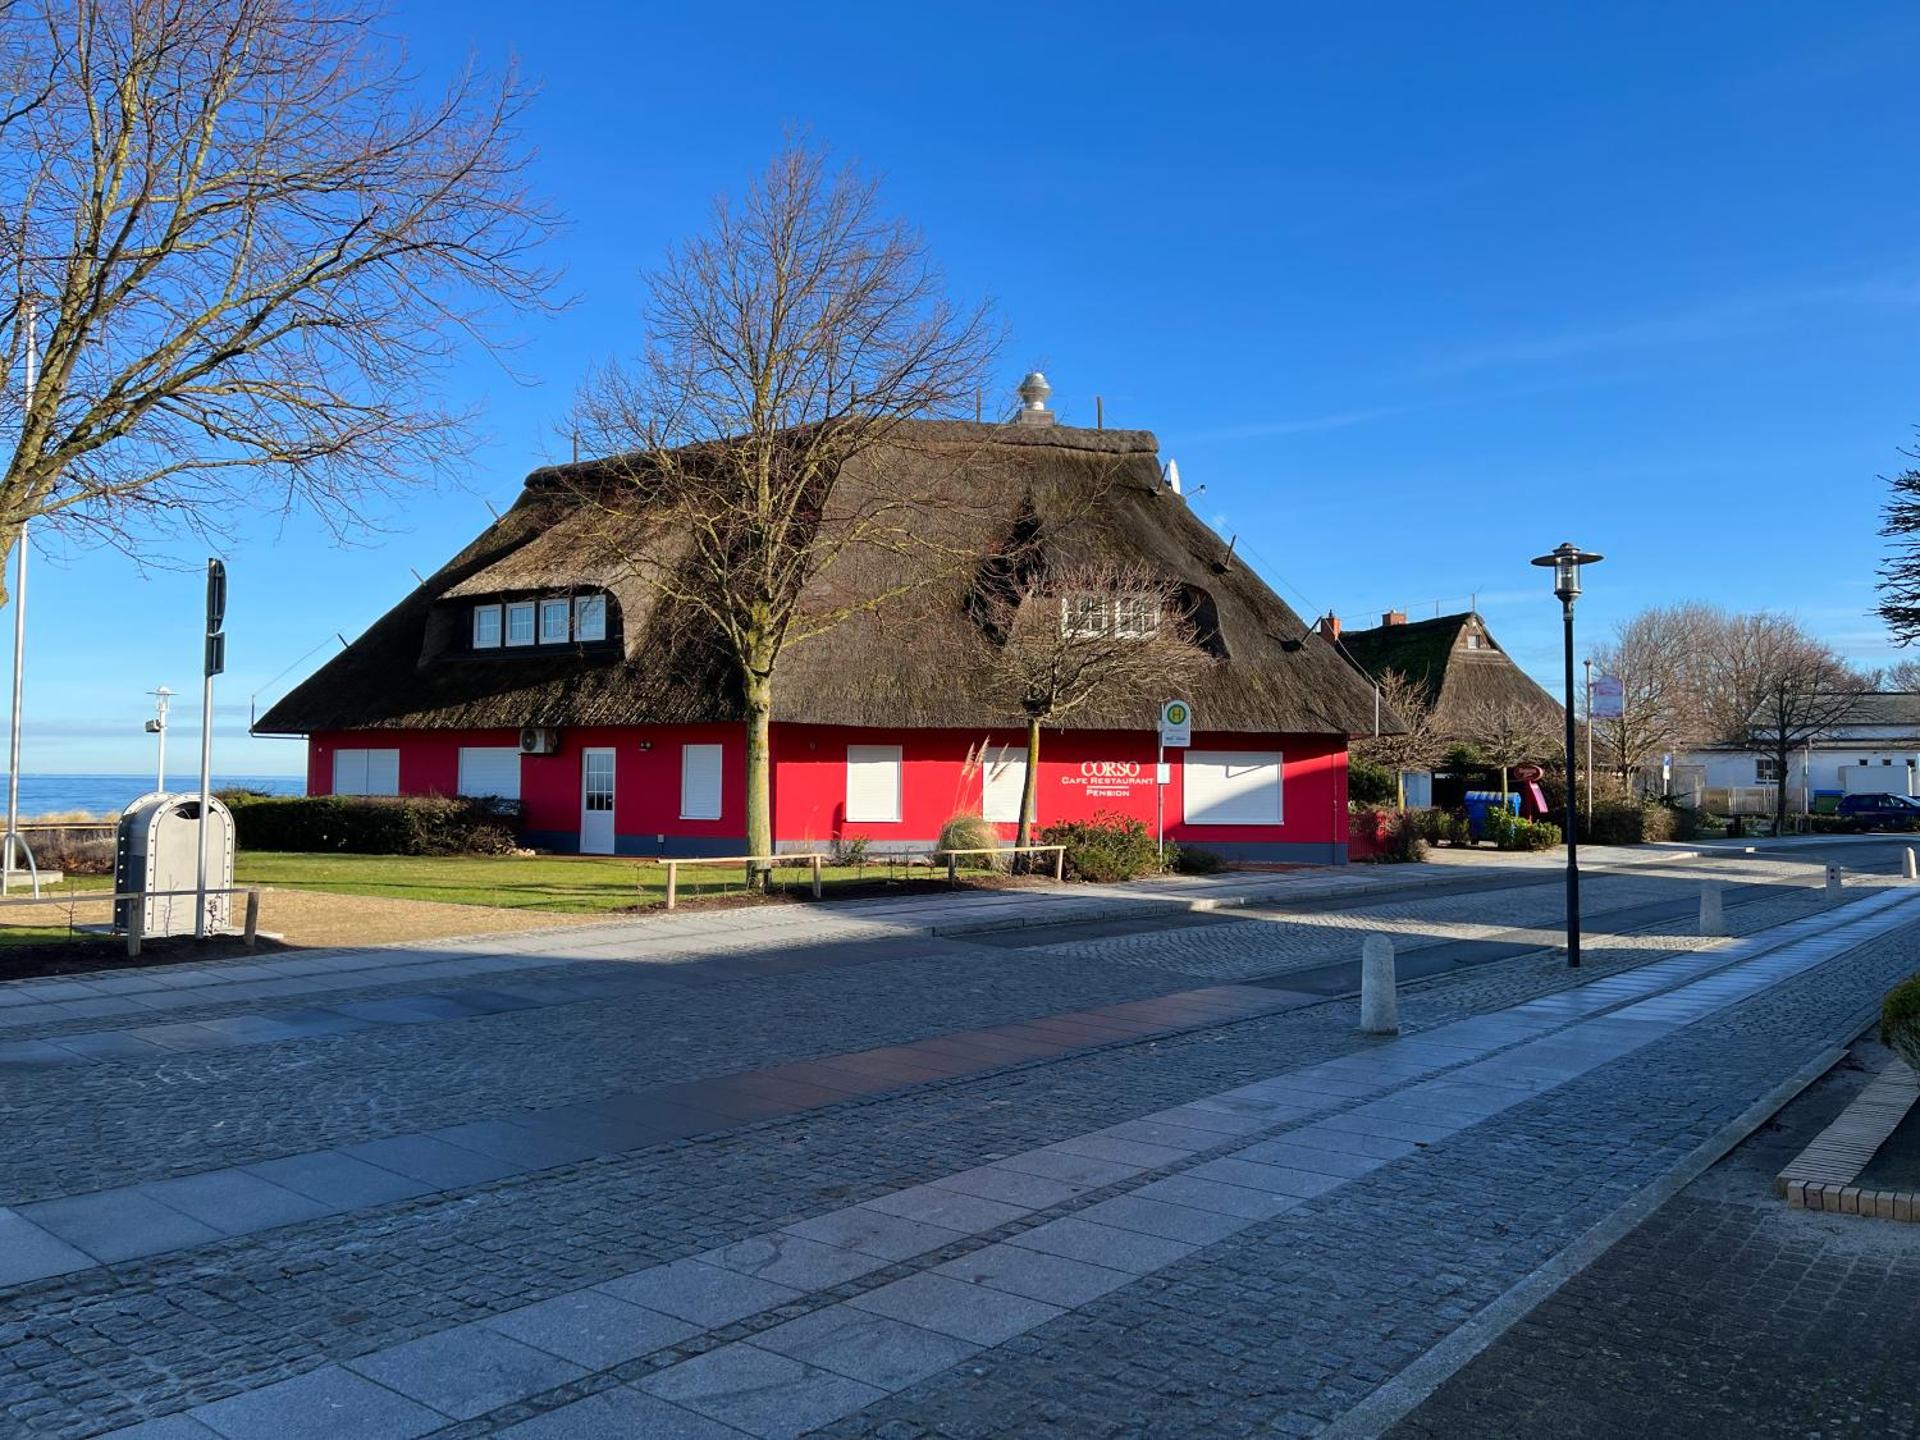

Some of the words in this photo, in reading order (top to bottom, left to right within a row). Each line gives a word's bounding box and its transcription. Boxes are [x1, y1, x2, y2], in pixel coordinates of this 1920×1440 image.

[1081, 761, 1140, 777] CORSO
[1090, 777, 1154, 785] RESTAURANT
[1086, 789, 1130, 797] PENSION
